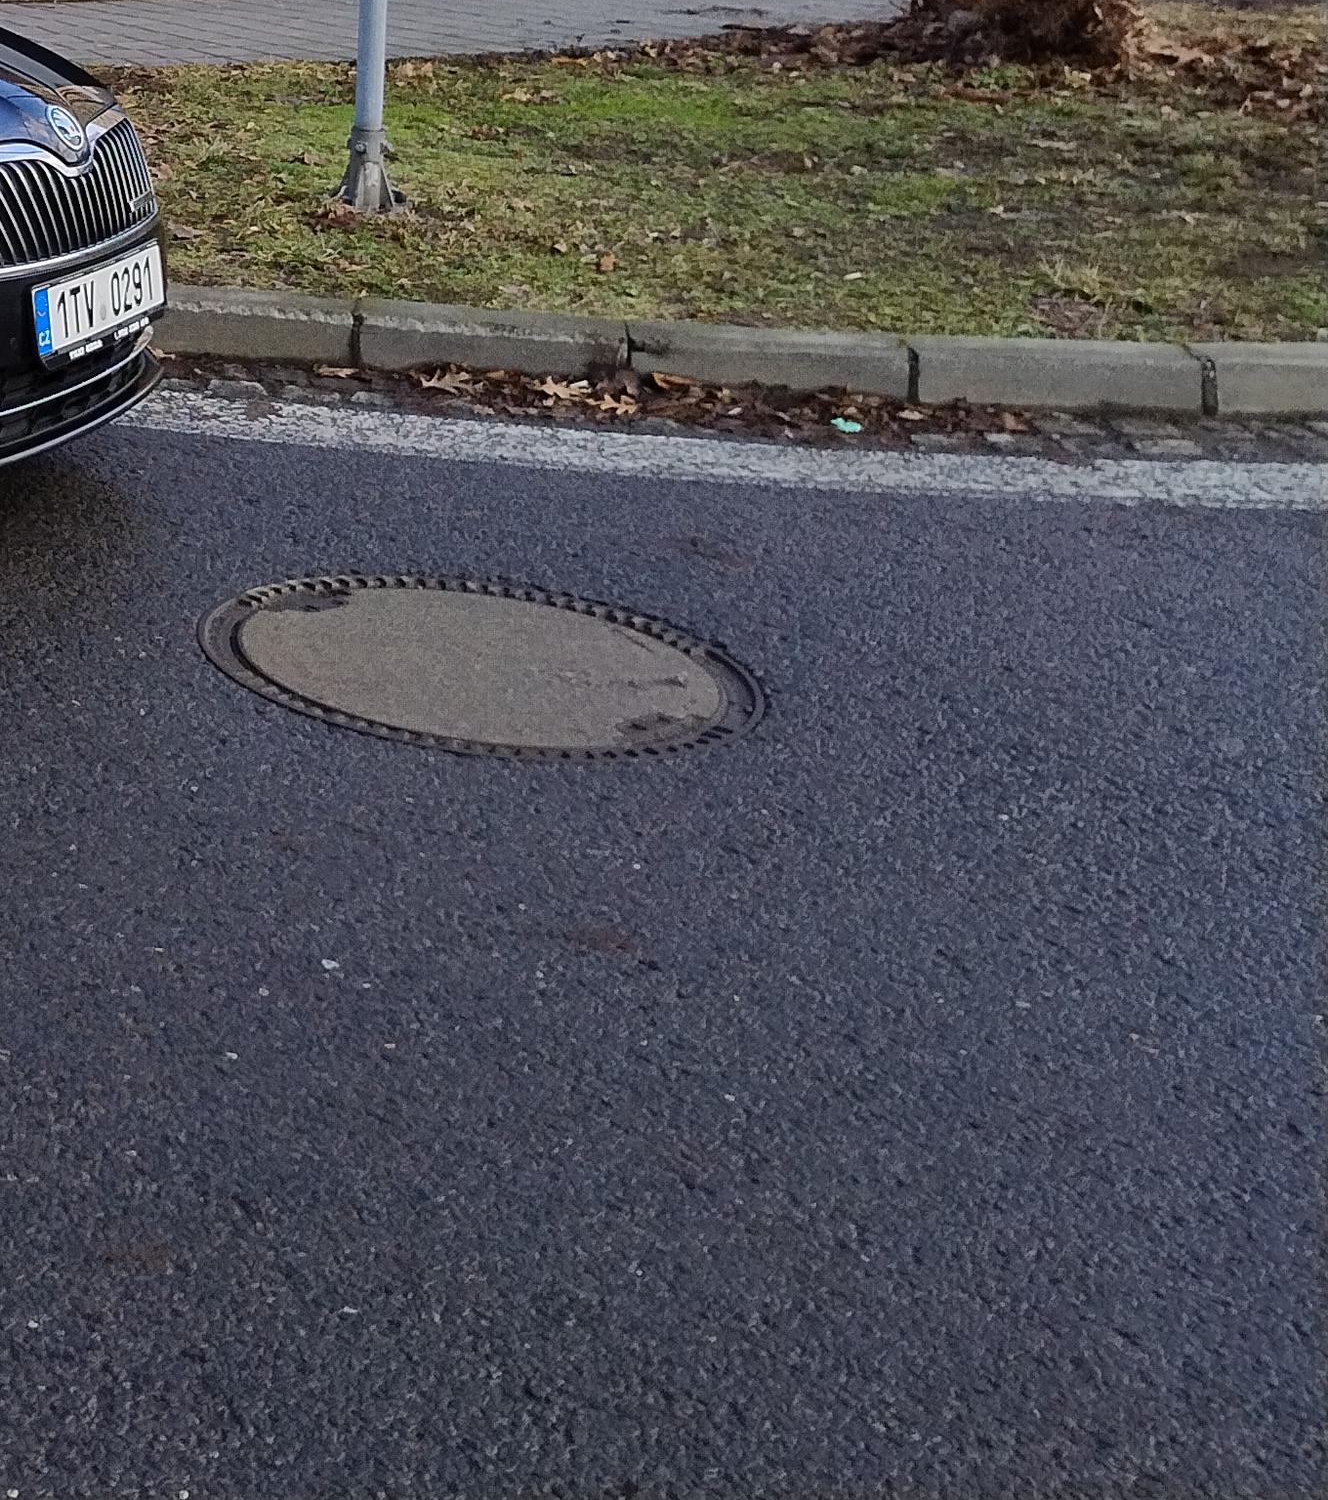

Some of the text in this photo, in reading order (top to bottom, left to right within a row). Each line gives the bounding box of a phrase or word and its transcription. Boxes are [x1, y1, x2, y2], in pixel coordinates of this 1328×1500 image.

[56, 280, 95, 338] 1TV
[110, 256, 153, 317] 0291
[38, 327, 50, 347] CZ
